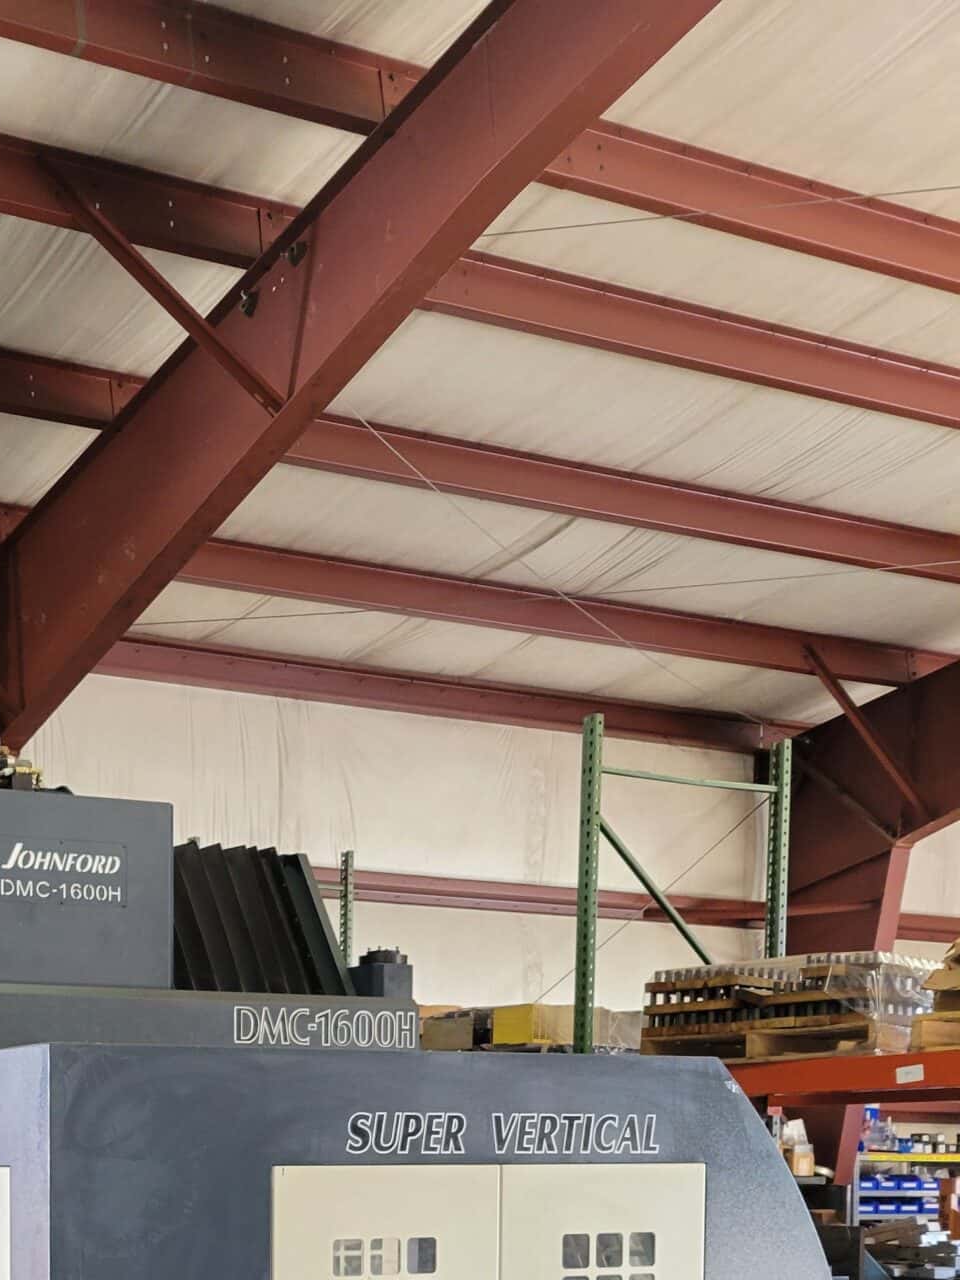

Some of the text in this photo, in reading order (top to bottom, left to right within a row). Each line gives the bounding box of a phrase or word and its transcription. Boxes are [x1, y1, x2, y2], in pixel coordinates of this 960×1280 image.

[1, 842, 121, 874] JOHNFORD
[0, 878, 121, 902] DMC-1600H
[234, 1006, 416, 1049] DMC-1600H
[346, 1111, 660, 1154] SUPER VERTICAL
